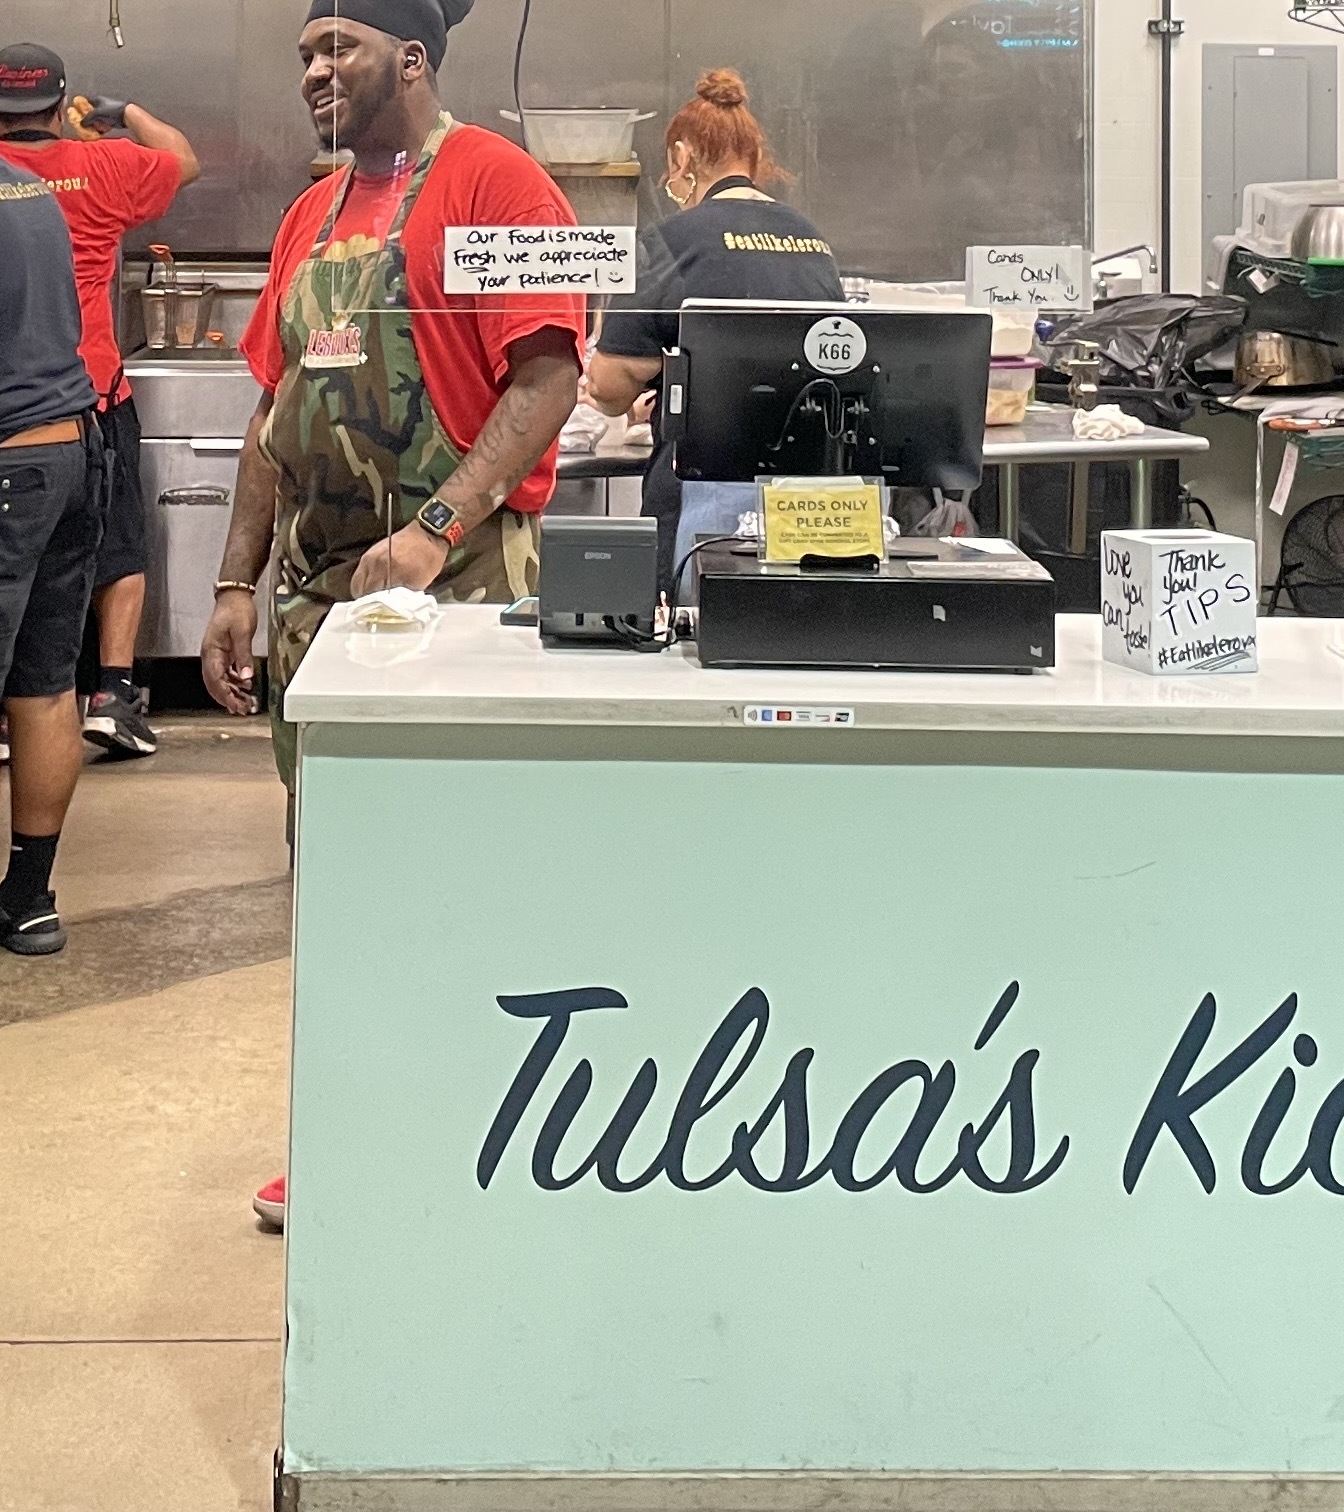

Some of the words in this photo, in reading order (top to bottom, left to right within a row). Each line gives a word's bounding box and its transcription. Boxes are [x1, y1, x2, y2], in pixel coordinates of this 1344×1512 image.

[466, 230, 499, 244] Our
[569, 228, 616, 246] made
[503, 251, 530, 265] we
[539, 248, 629, 266] appreciate
[477, 274, 511, 292] your
[518, 267, 600, 289] patience!
[982, 285, 1022, 305] Thank
[818, 343, 852, 361] K66
[776, 500, 827, 512] CARDS
[830, 499, 869, 512] ONLY
[796, 516, 853, 529] PLEASE
[1159, 549, 1227, 575] Thank
[1122, 580, 1145, 616] you
[1159, 573, 1251, 636] TIPS
[476, 980, 1071, 1194] Tulsa's
